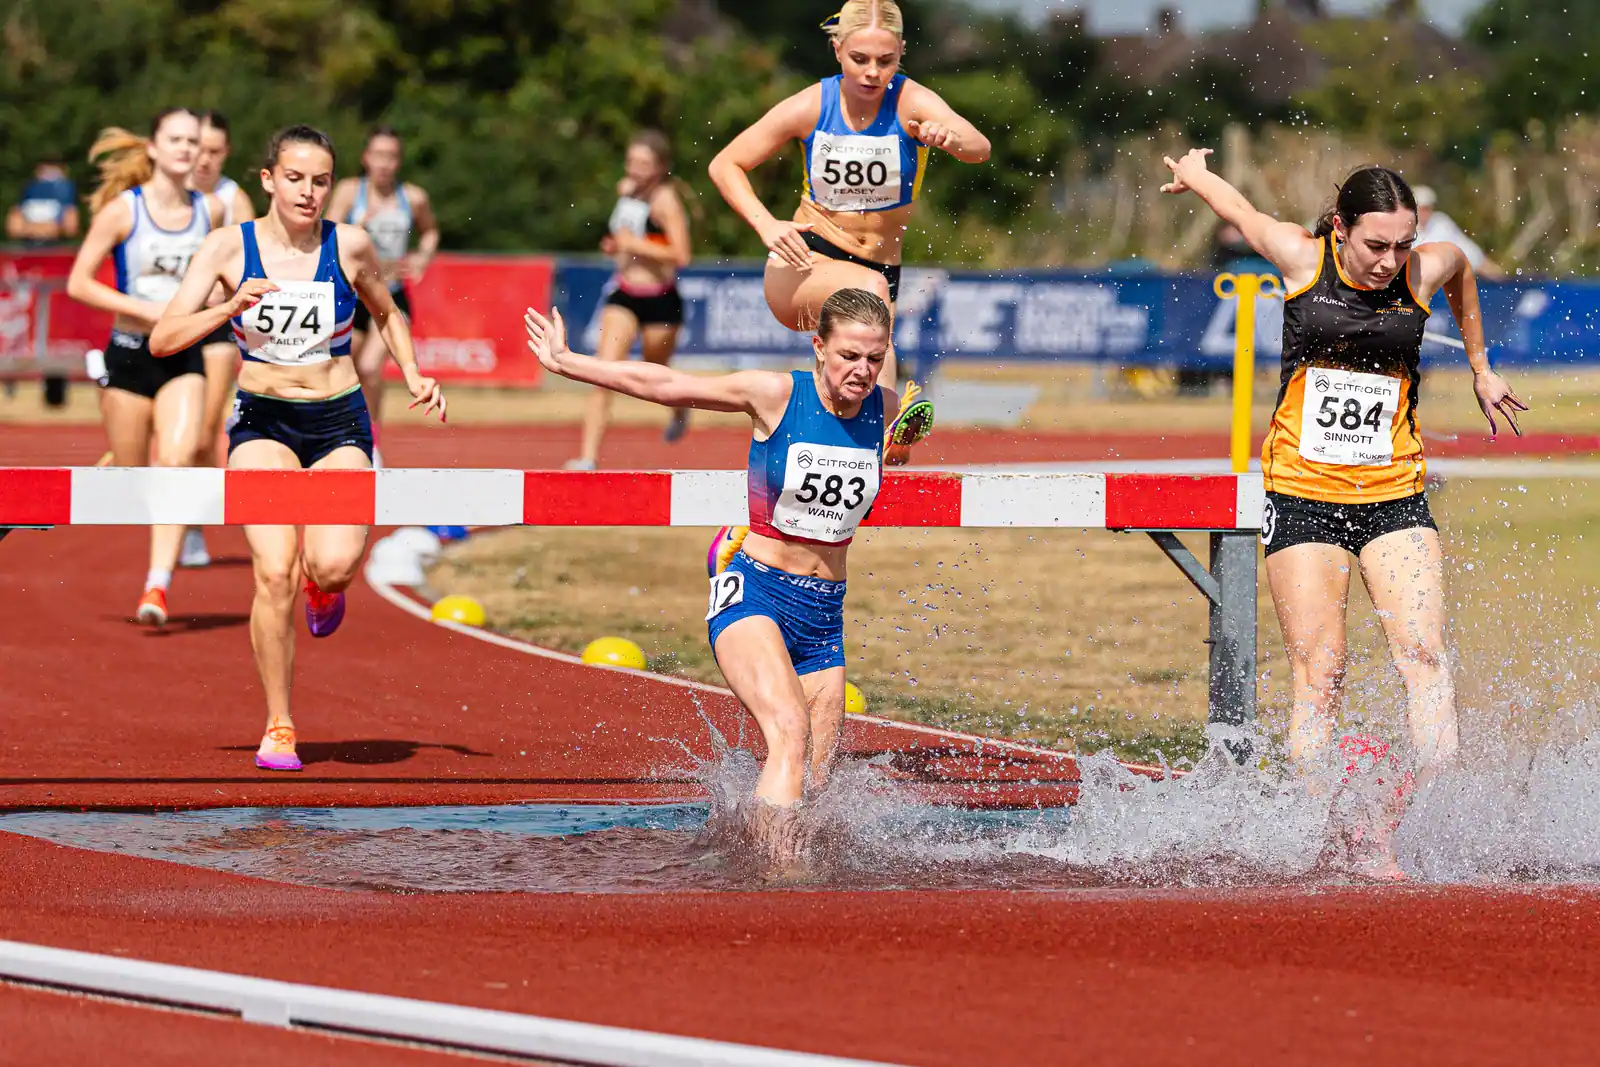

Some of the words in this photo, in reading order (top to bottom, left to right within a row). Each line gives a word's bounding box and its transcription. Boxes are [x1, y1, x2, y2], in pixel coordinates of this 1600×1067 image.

[821, 159, 887, 187] 580
[153, 255, 193, 283] 57
[255, 304, 321, 335] 574
[270, 336, 308, 346] BAILEY
[1315, 396, 1384, 433] 584
[1323, 431, 1374, 445] SINNOTT
[794, 472, 866, 510] 583
[808, 506, 844, 521] WARN
[713, 575, 740, 612] 12
[779, 574, 832, 594] NIKE
